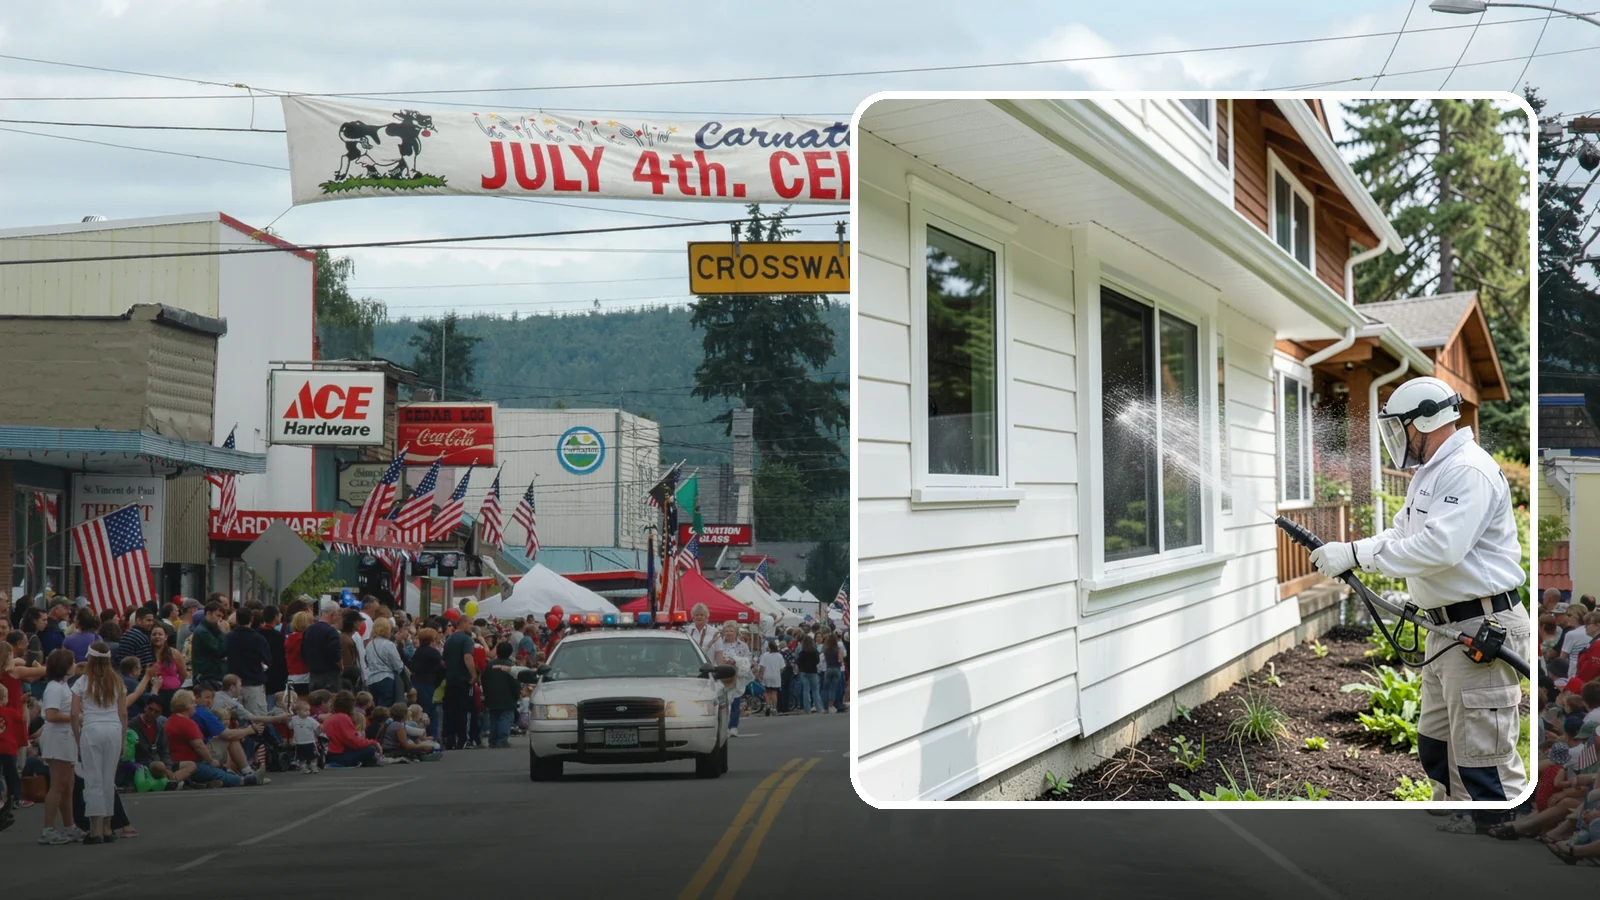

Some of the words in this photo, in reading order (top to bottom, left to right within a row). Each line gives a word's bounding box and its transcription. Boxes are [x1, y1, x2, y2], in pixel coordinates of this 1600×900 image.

[695, 121, 850, 149] Carnat
[481, 141, 605, 192] JULY
[632, 150, 746, 197] 4th.
[697, 254, 850, 280] CROSSWA
[283, 380, 373, 420] ACE
[406, 409, 452, 421] CEDAR
[461, 409, 484, 421] LOG
[283, 421, 370, 436] Hardware
[416, 428, 476, 446] Coca-Cola
[353, 467, 384, 480] Simpl
[96, 485, 124, 495] Vincent
[126, 486, 136, 495] de
[137, 486, 155, 495] Paul
[81, 503, 153, 521] THT
[688, 526, 741, 535] CRNATION
